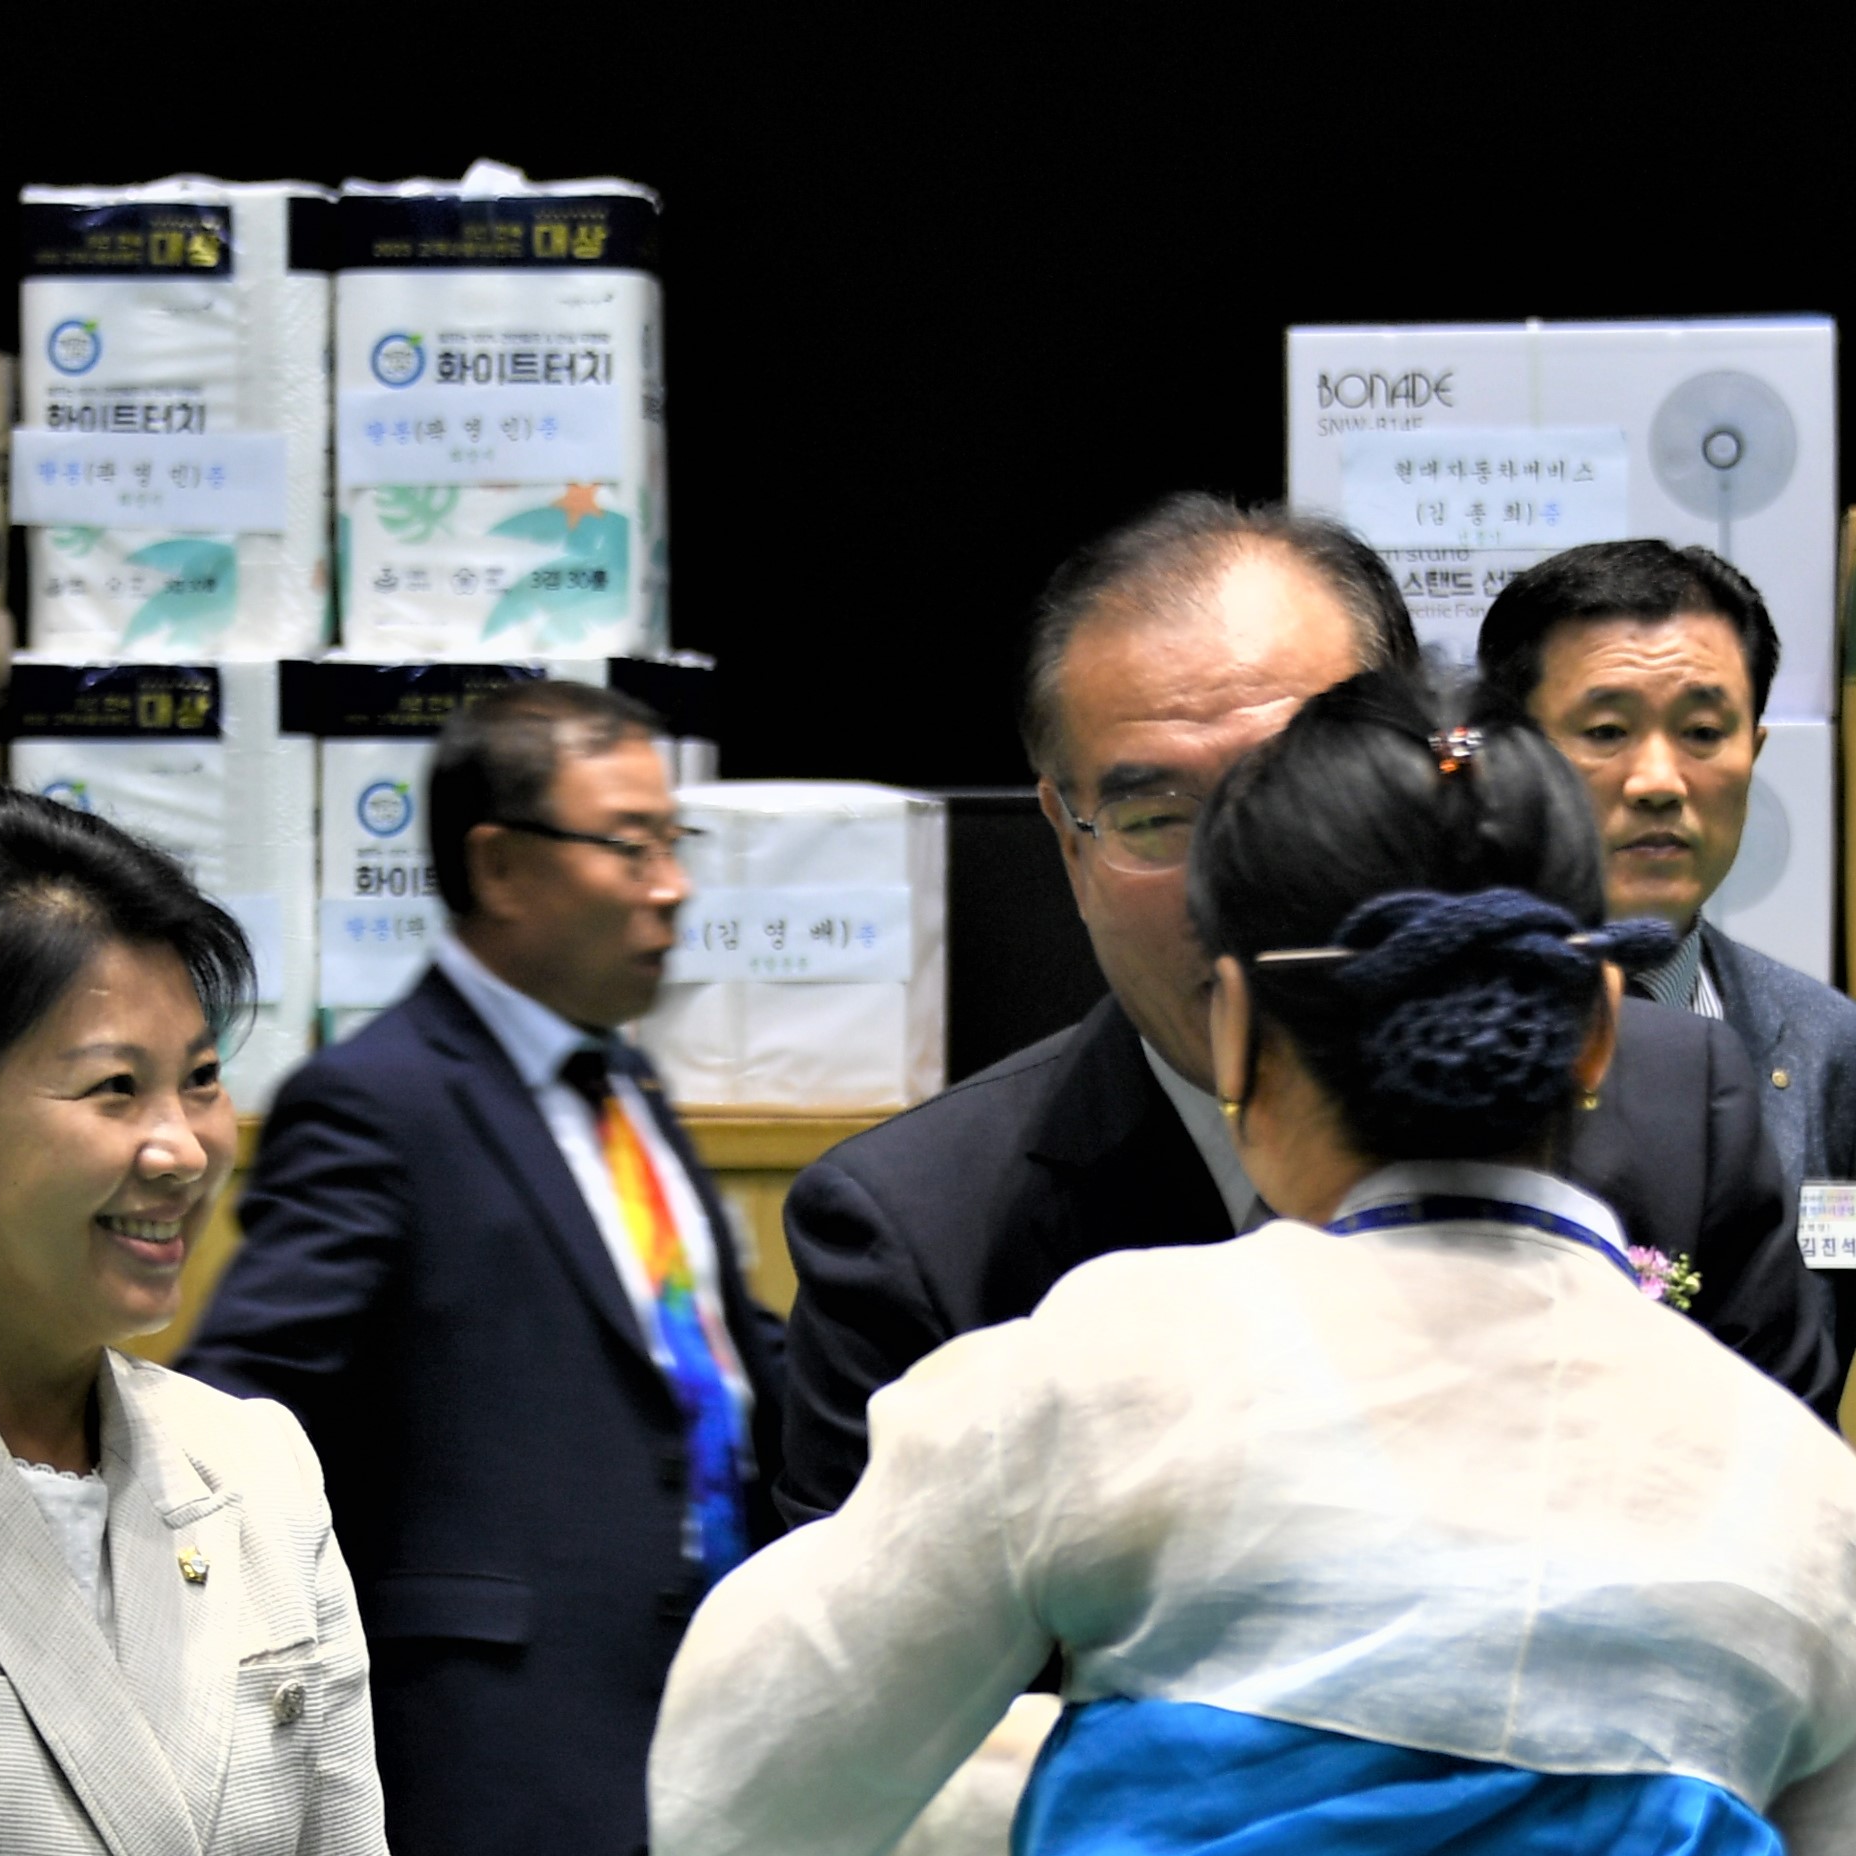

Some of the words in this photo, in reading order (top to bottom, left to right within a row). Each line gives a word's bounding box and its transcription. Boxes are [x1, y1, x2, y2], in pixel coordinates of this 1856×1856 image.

[435, 351, 612, 386] 화이트터치
[1316, 371, 1456, 410] BONADE
[1402, 568, 1475, 599] 스탠드
